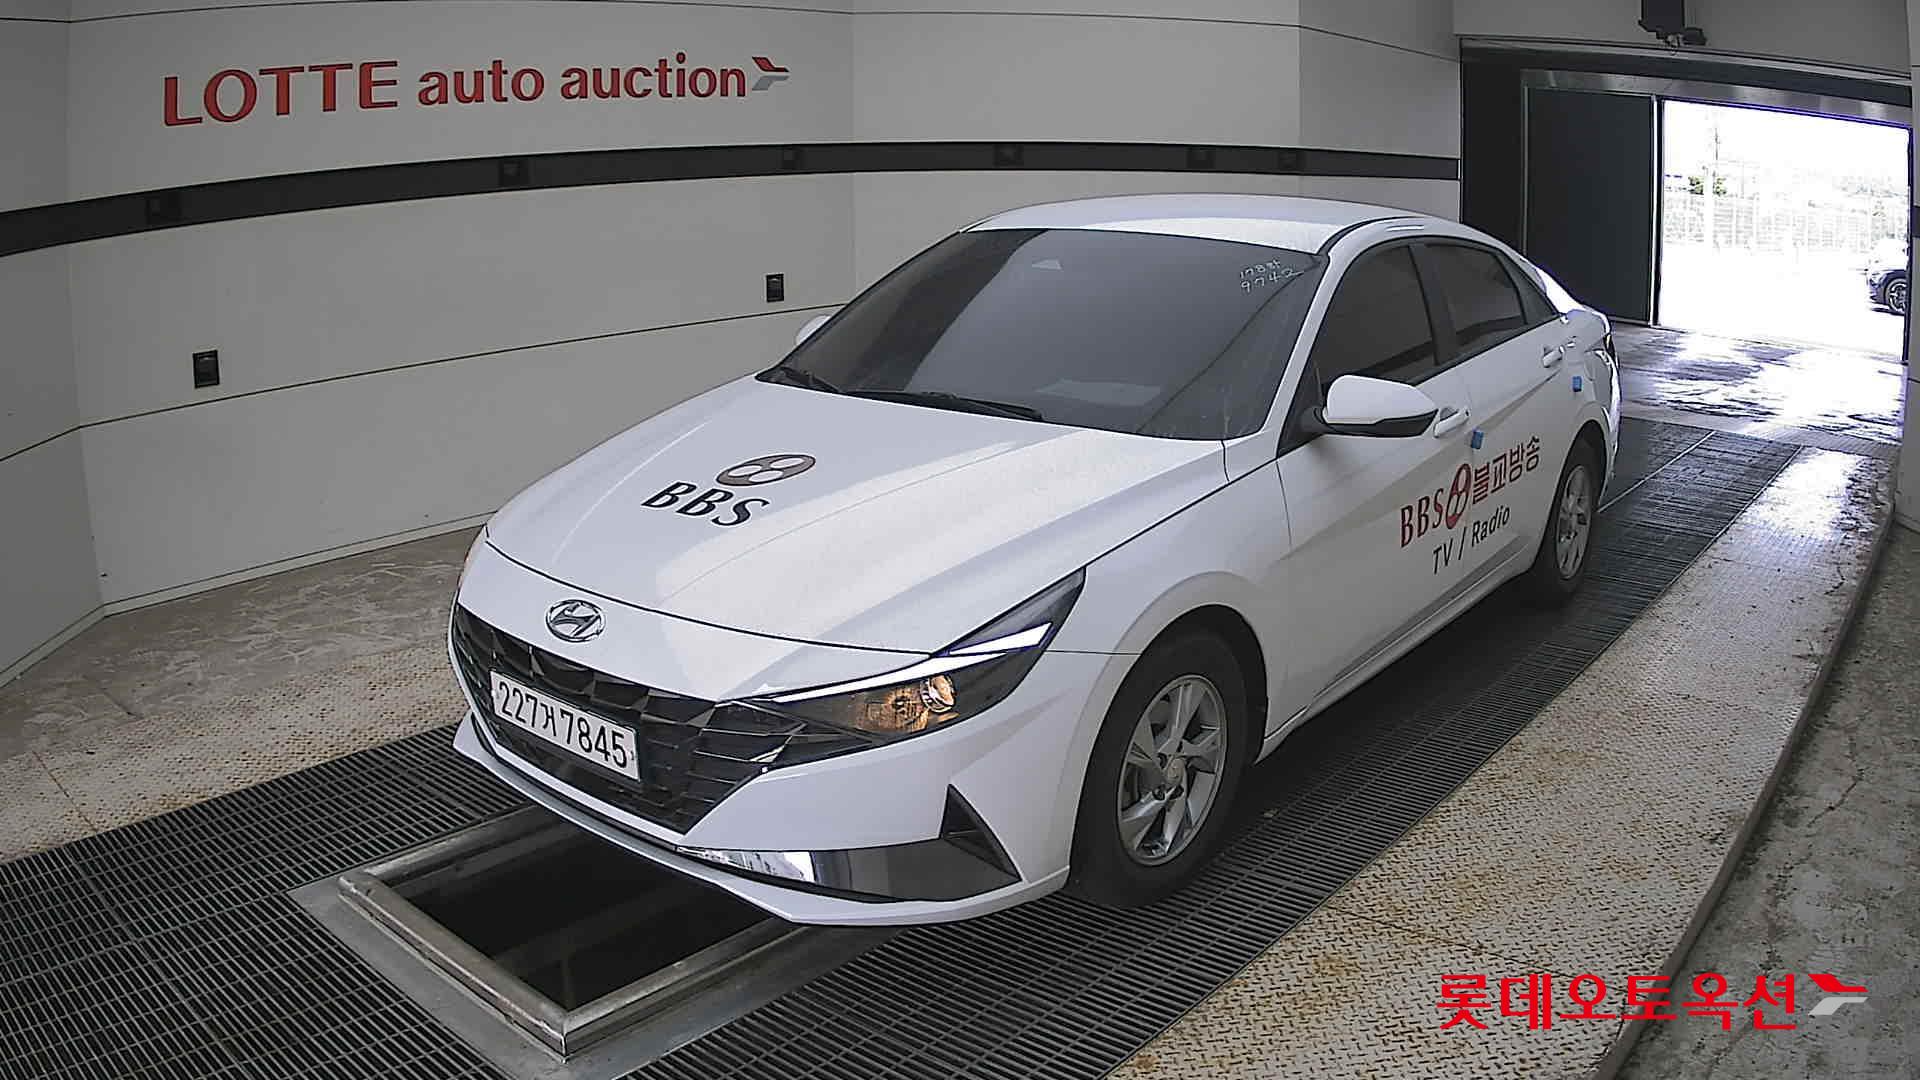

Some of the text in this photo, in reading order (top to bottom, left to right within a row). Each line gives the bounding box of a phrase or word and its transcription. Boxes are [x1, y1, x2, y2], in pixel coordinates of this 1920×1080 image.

[164, 52, 748, 127] LOTTE auto auction
[640, 481, 771, 527] BBS
[1401, 435, 1541, 549] BBS 불교방송
[1433, 538, 1454, 575] TV
[1471, 505, 1510, 548] Radio
